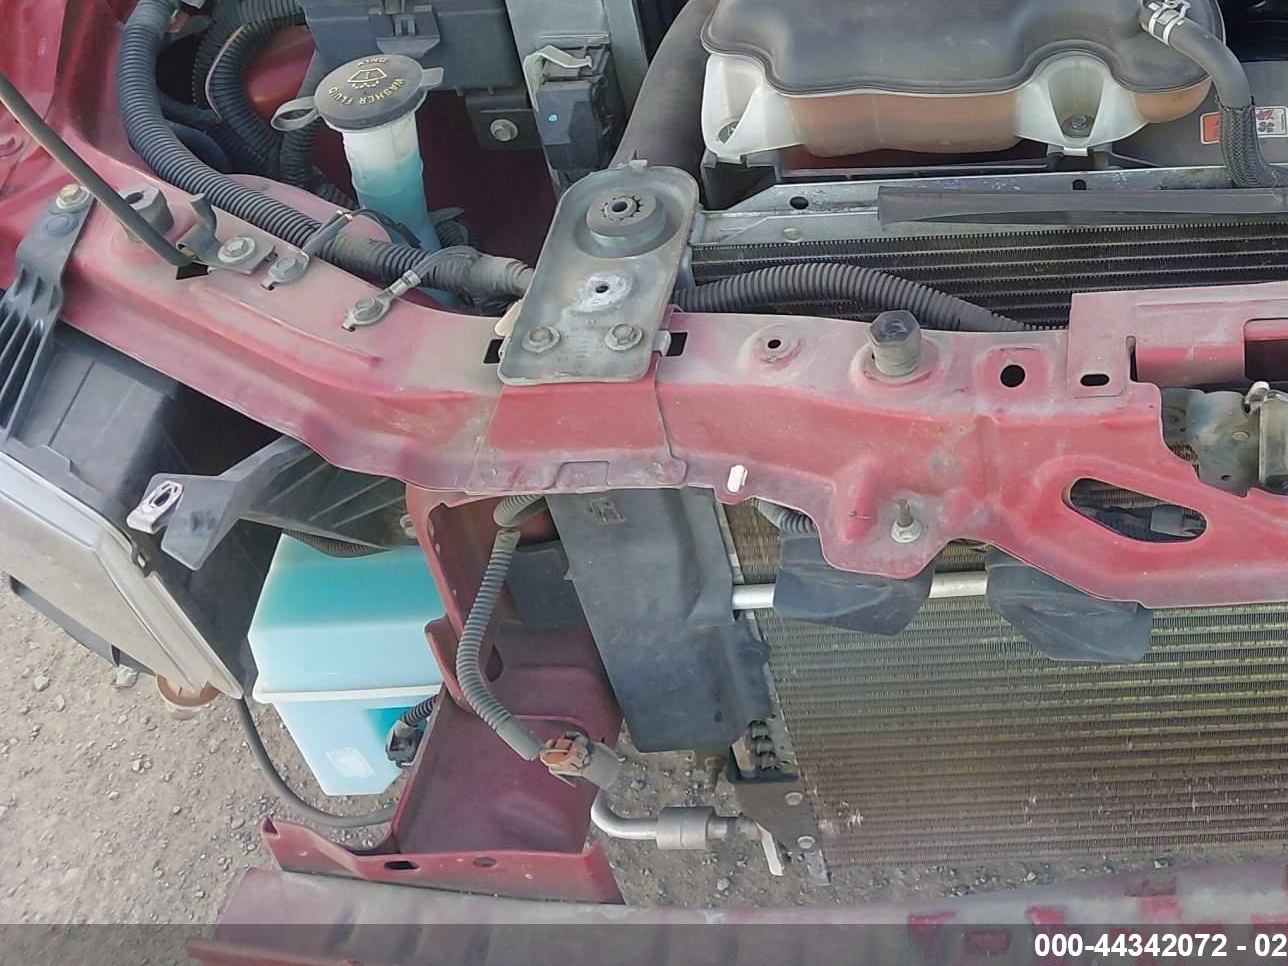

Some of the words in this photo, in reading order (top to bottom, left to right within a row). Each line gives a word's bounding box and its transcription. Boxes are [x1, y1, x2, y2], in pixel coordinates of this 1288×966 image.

[358, 57, 389, 68] ONLY
[328, 86, 354, 105] FLUID
[358, 77, 406, 105] WASHER
